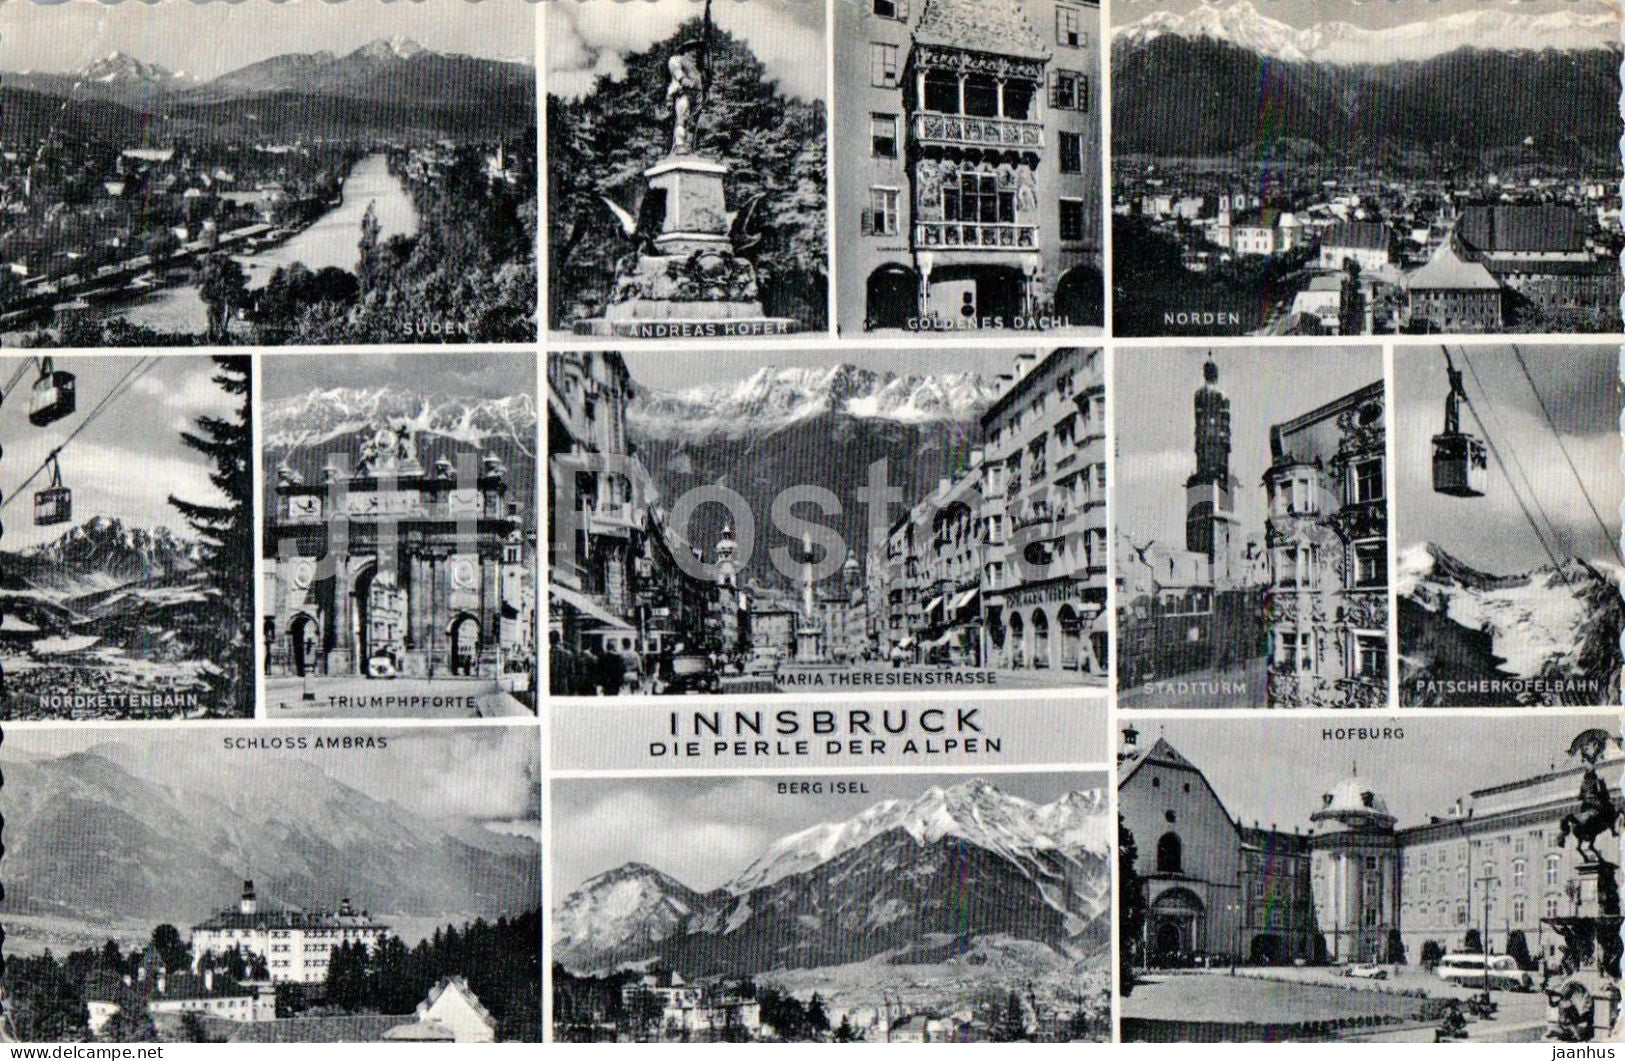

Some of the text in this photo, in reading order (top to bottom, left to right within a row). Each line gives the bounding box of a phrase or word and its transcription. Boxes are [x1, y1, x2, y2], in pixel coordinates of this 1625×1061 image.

[907, 315, 1005, 330] GOLDENES
[1163, 311, 1241, 326] NORDEN
[629, 320, 789, 337] ANDREAS HOFER
[772, 669, 998, 687] MARIA THERESIENSTRASSE
[1143, 682, 1247, 696] STADTTURM
[1415, 679, 1600, 694] PATSCHERKOFELBAHN
[38, 694, 199, 709] NORDKETTENBAHN
[327, 695, 477, 710] TRIUMPHPFORTE
[669, 708, 983, 735] INNSBRUCK
[1321, 727, 1406, 742] HOFBURG
[223, 735, 389, 750] SCHLOSS AMBRAS
[649, 737, 1003, 757] DIE PERLE DER ALPEN
[777, 781, 871, 796] BERG ISEL
